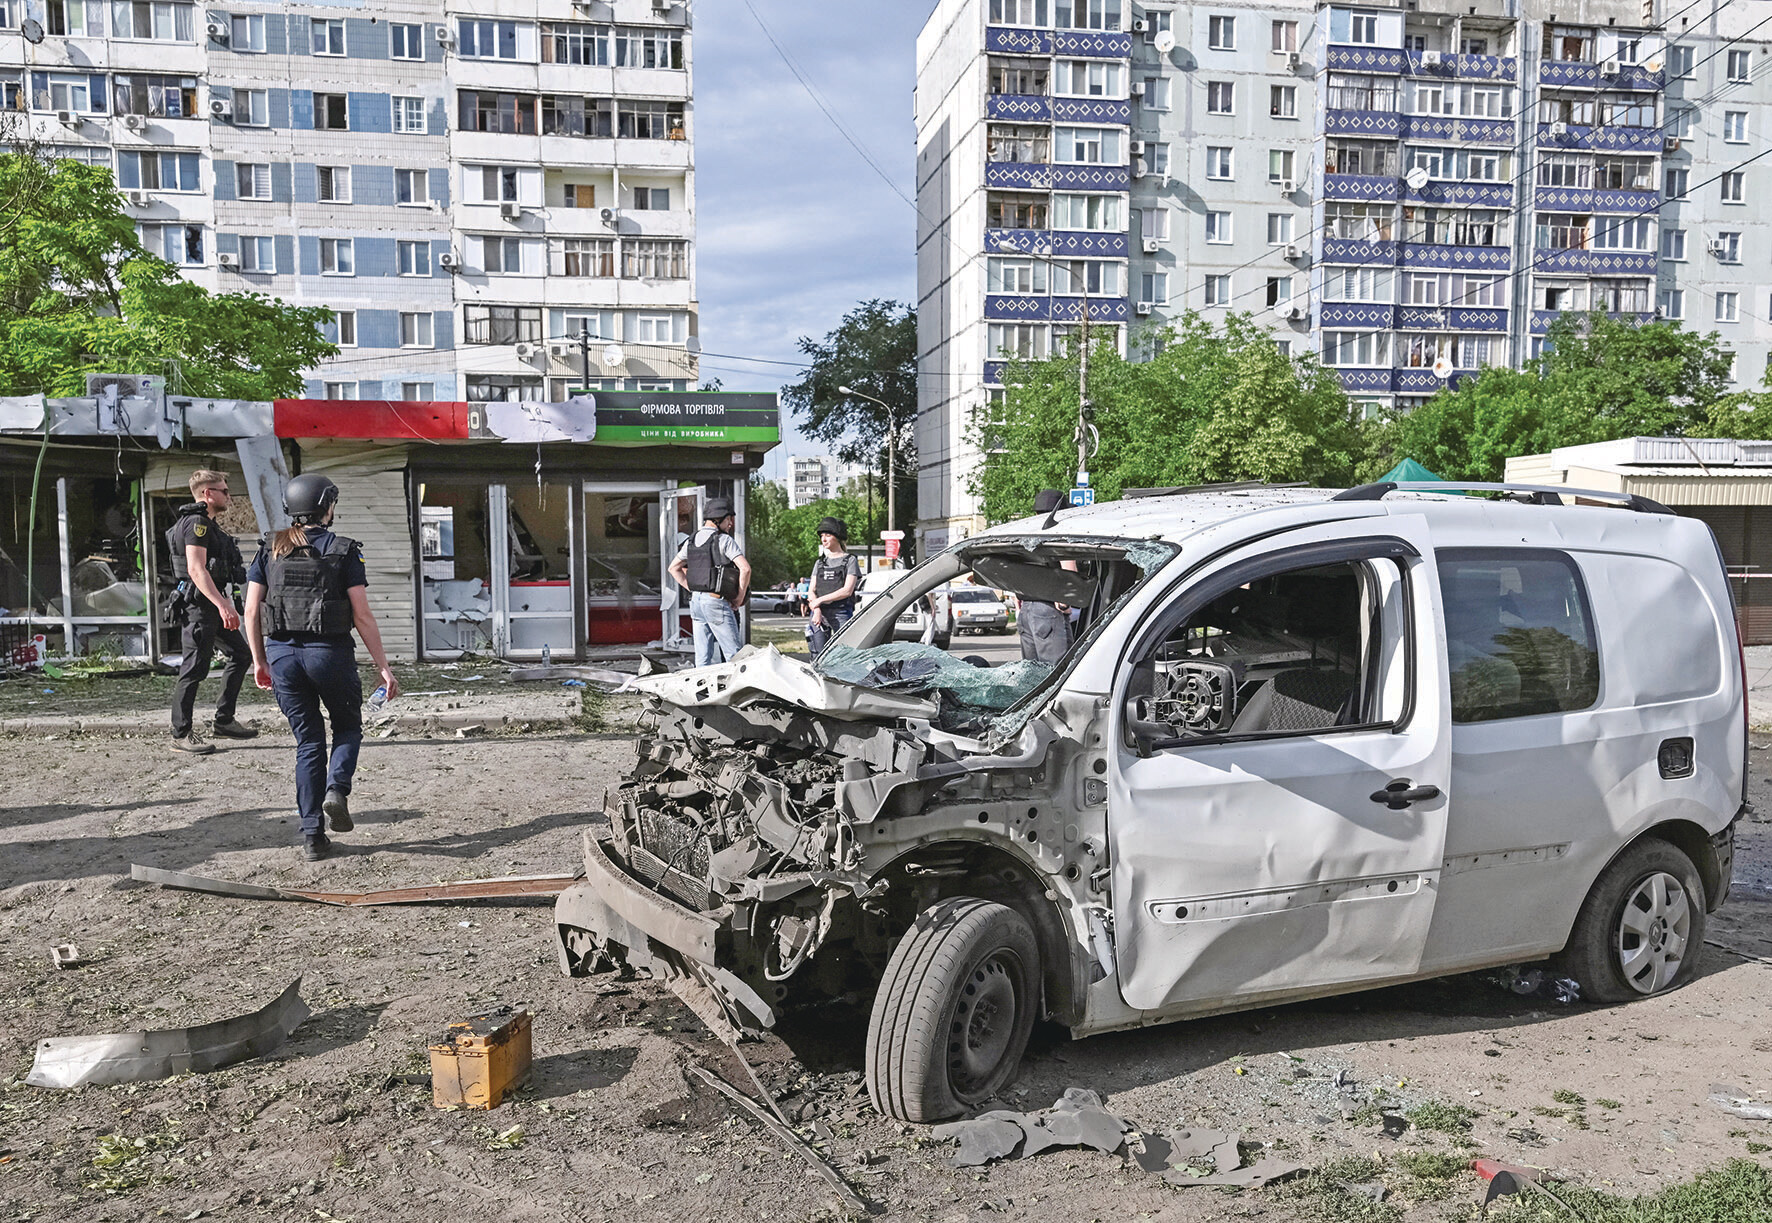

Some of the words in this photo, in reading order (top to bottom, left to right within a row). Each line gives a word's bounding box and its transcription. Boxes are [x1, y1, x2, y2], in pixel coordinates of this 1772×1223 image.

[640, 404, 681, 415] ФІРМОВА
[684, 404, 725, 415] ТОРГІВЛЯ
[664, 430, 677, 438] ВІД
